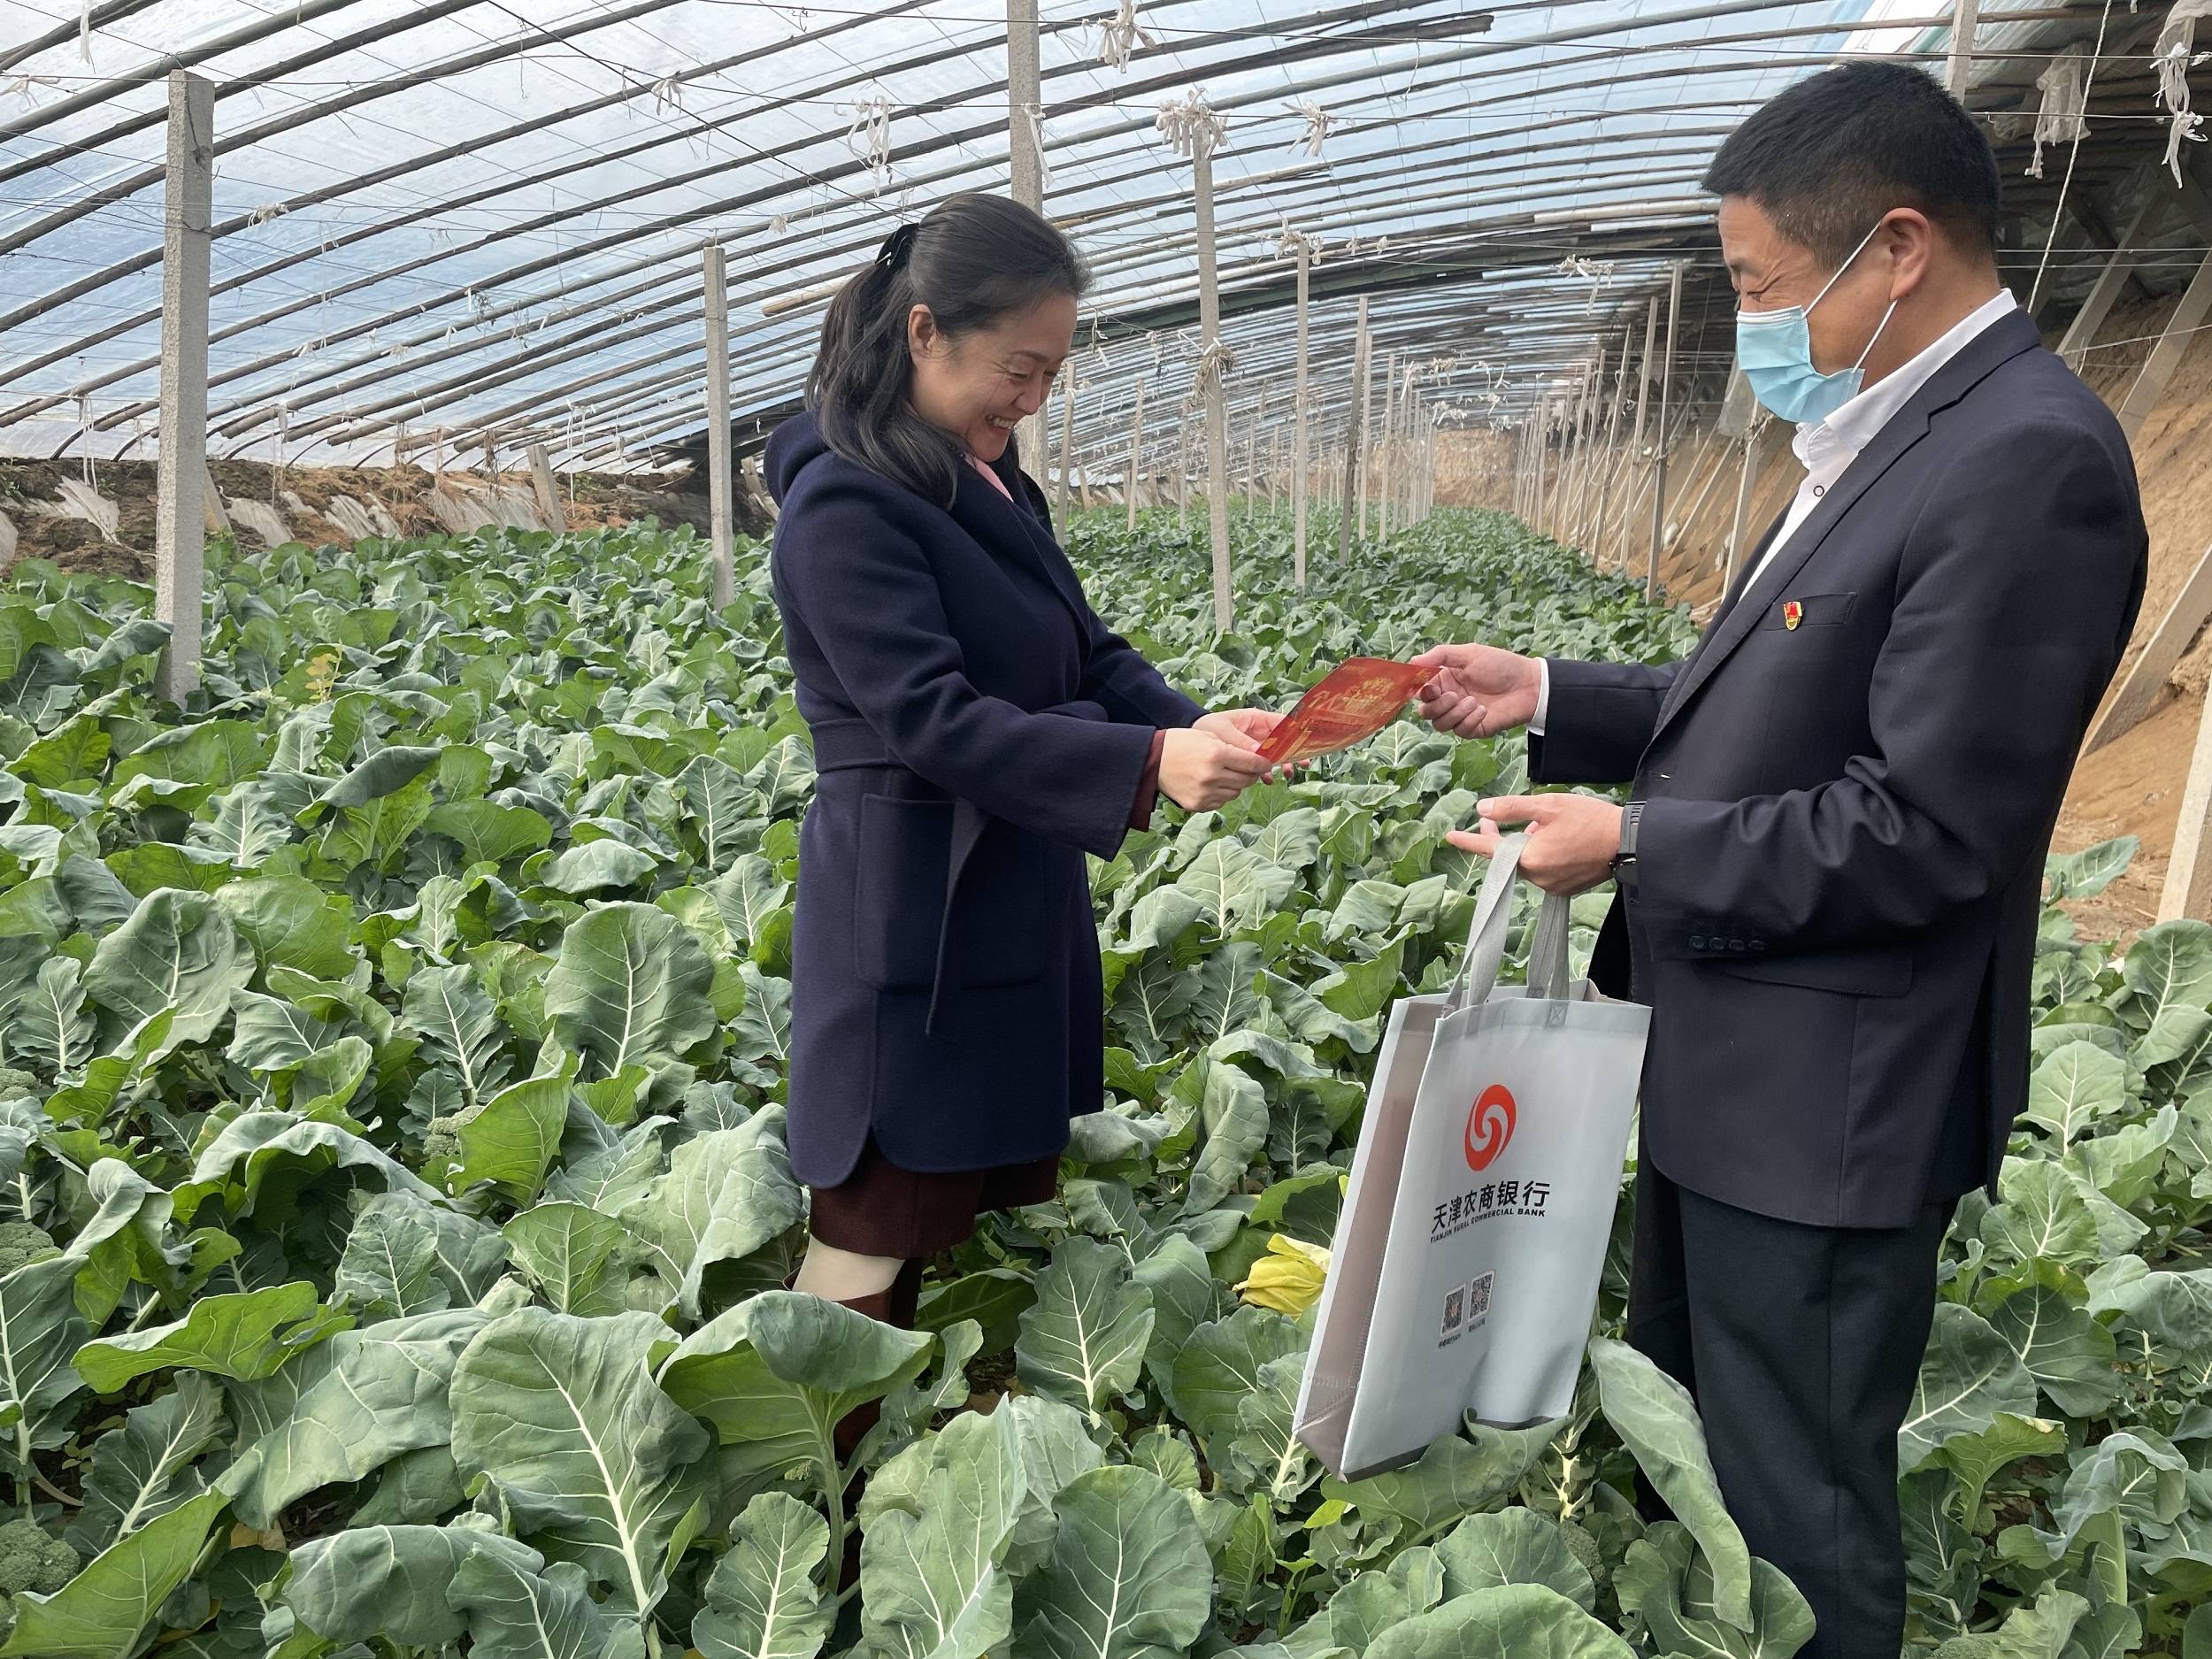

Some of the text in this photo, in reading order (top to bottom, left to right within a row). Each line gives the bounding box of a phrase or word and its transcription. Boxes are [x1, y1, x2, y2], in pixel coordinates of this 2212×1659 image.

[1430, 1228, 1452, 1244] TIANJIN
[1471, 1208, 1514, 1225] COMMERCIAL
[1517, 1208, 1546, 1217] BANK
[1432, 1180, 1550, 1233] 天津农商银行
